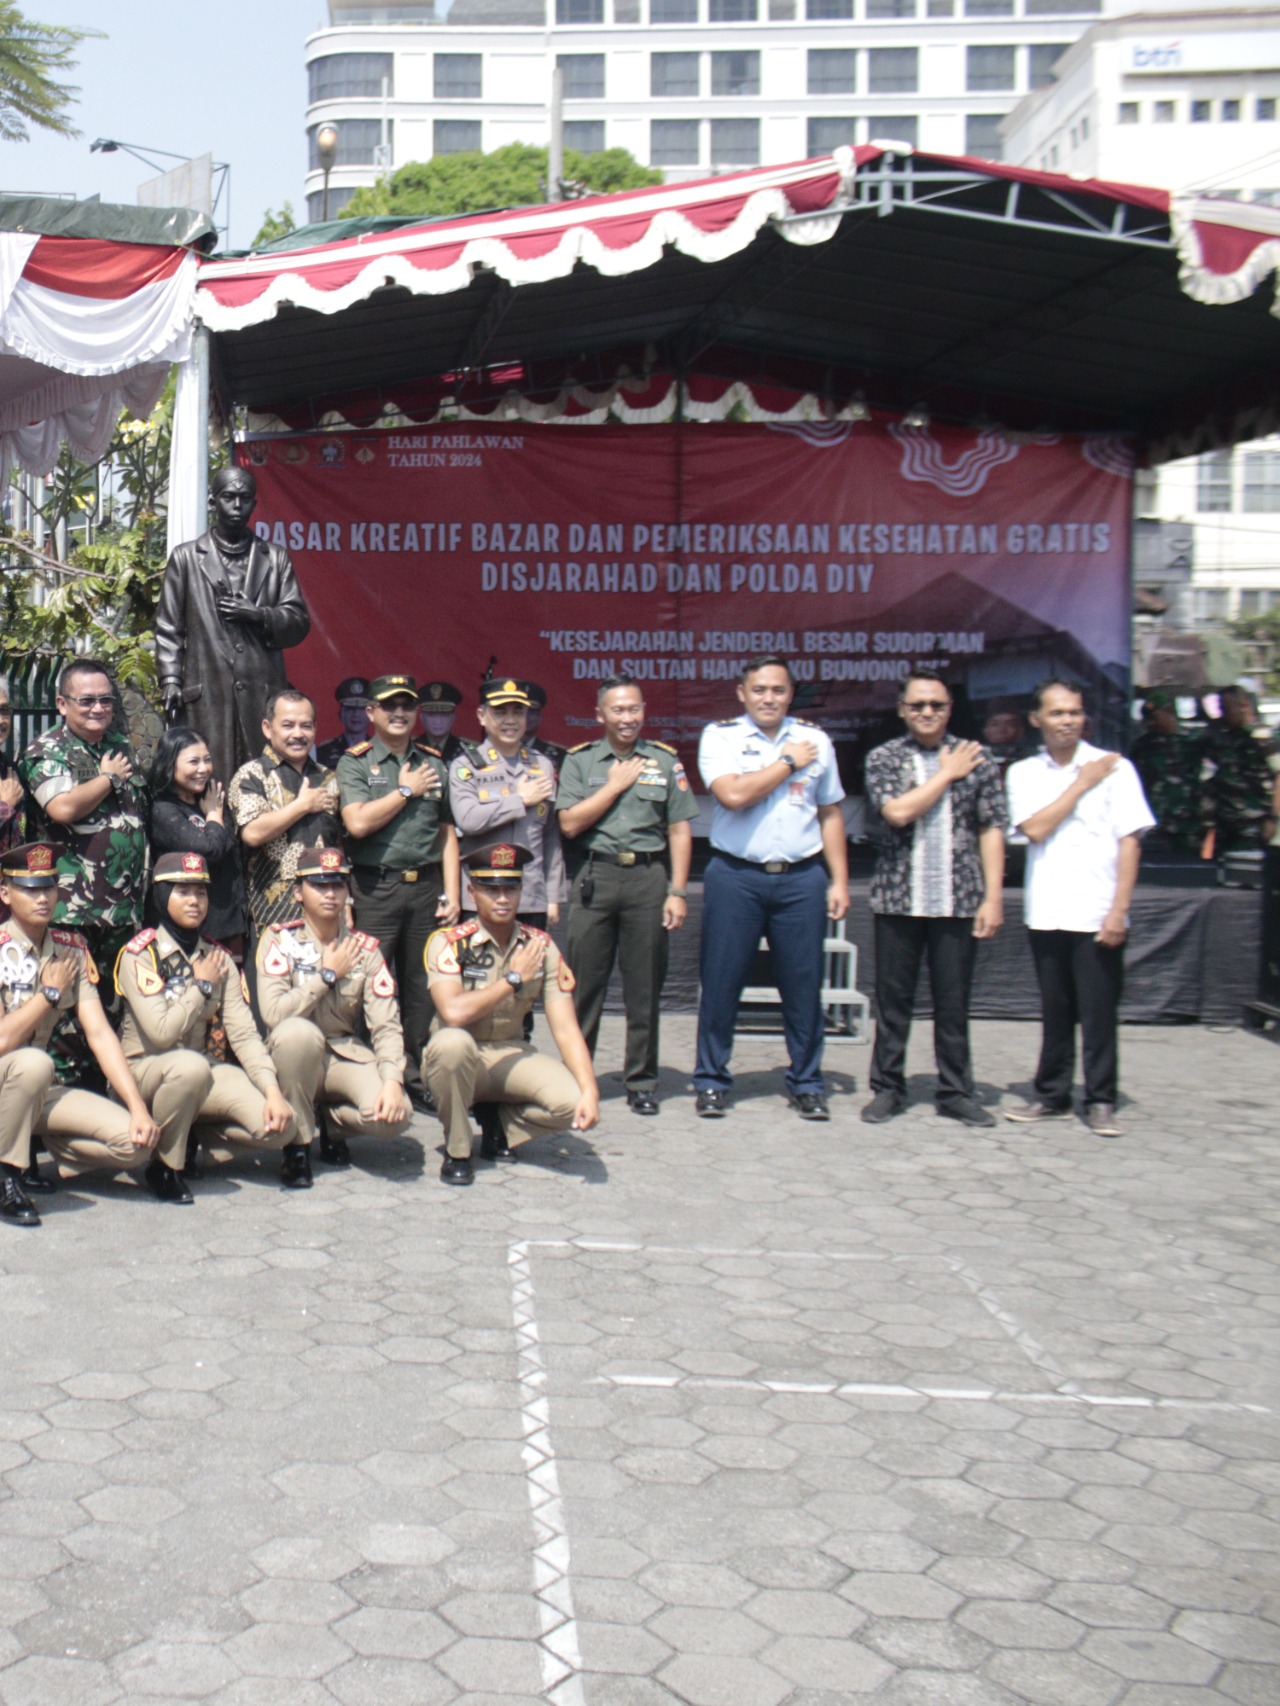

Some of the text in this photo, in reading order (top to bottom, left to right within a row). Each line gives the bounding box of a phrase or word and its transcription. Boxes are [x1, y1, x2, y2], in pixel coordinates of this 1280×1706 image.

[388, 436, 524, 450] HARI PAHLAWAN
[388, 454, 482, 468] TAHUN 2024
[255, 521, 1112, 555] PASAR KREATIF BAZAR DAN PEMERIKSAAN KESEHATAN GRATIS
[481, 562, 875, 594] DISJARAHAD DAN POLDA DIY
[698, 631, 799, 653] JENDERAL
[803, 631, 868, 654] BESAR
[873, 631, 985, 654] SUDIRMAN
[573, 658, 616, 681] DAN
[621, 658, 697, 681] SULTAN
[702, 659, 815, 682] HAMKU
[821, 659, 911, 683] BUWONO
